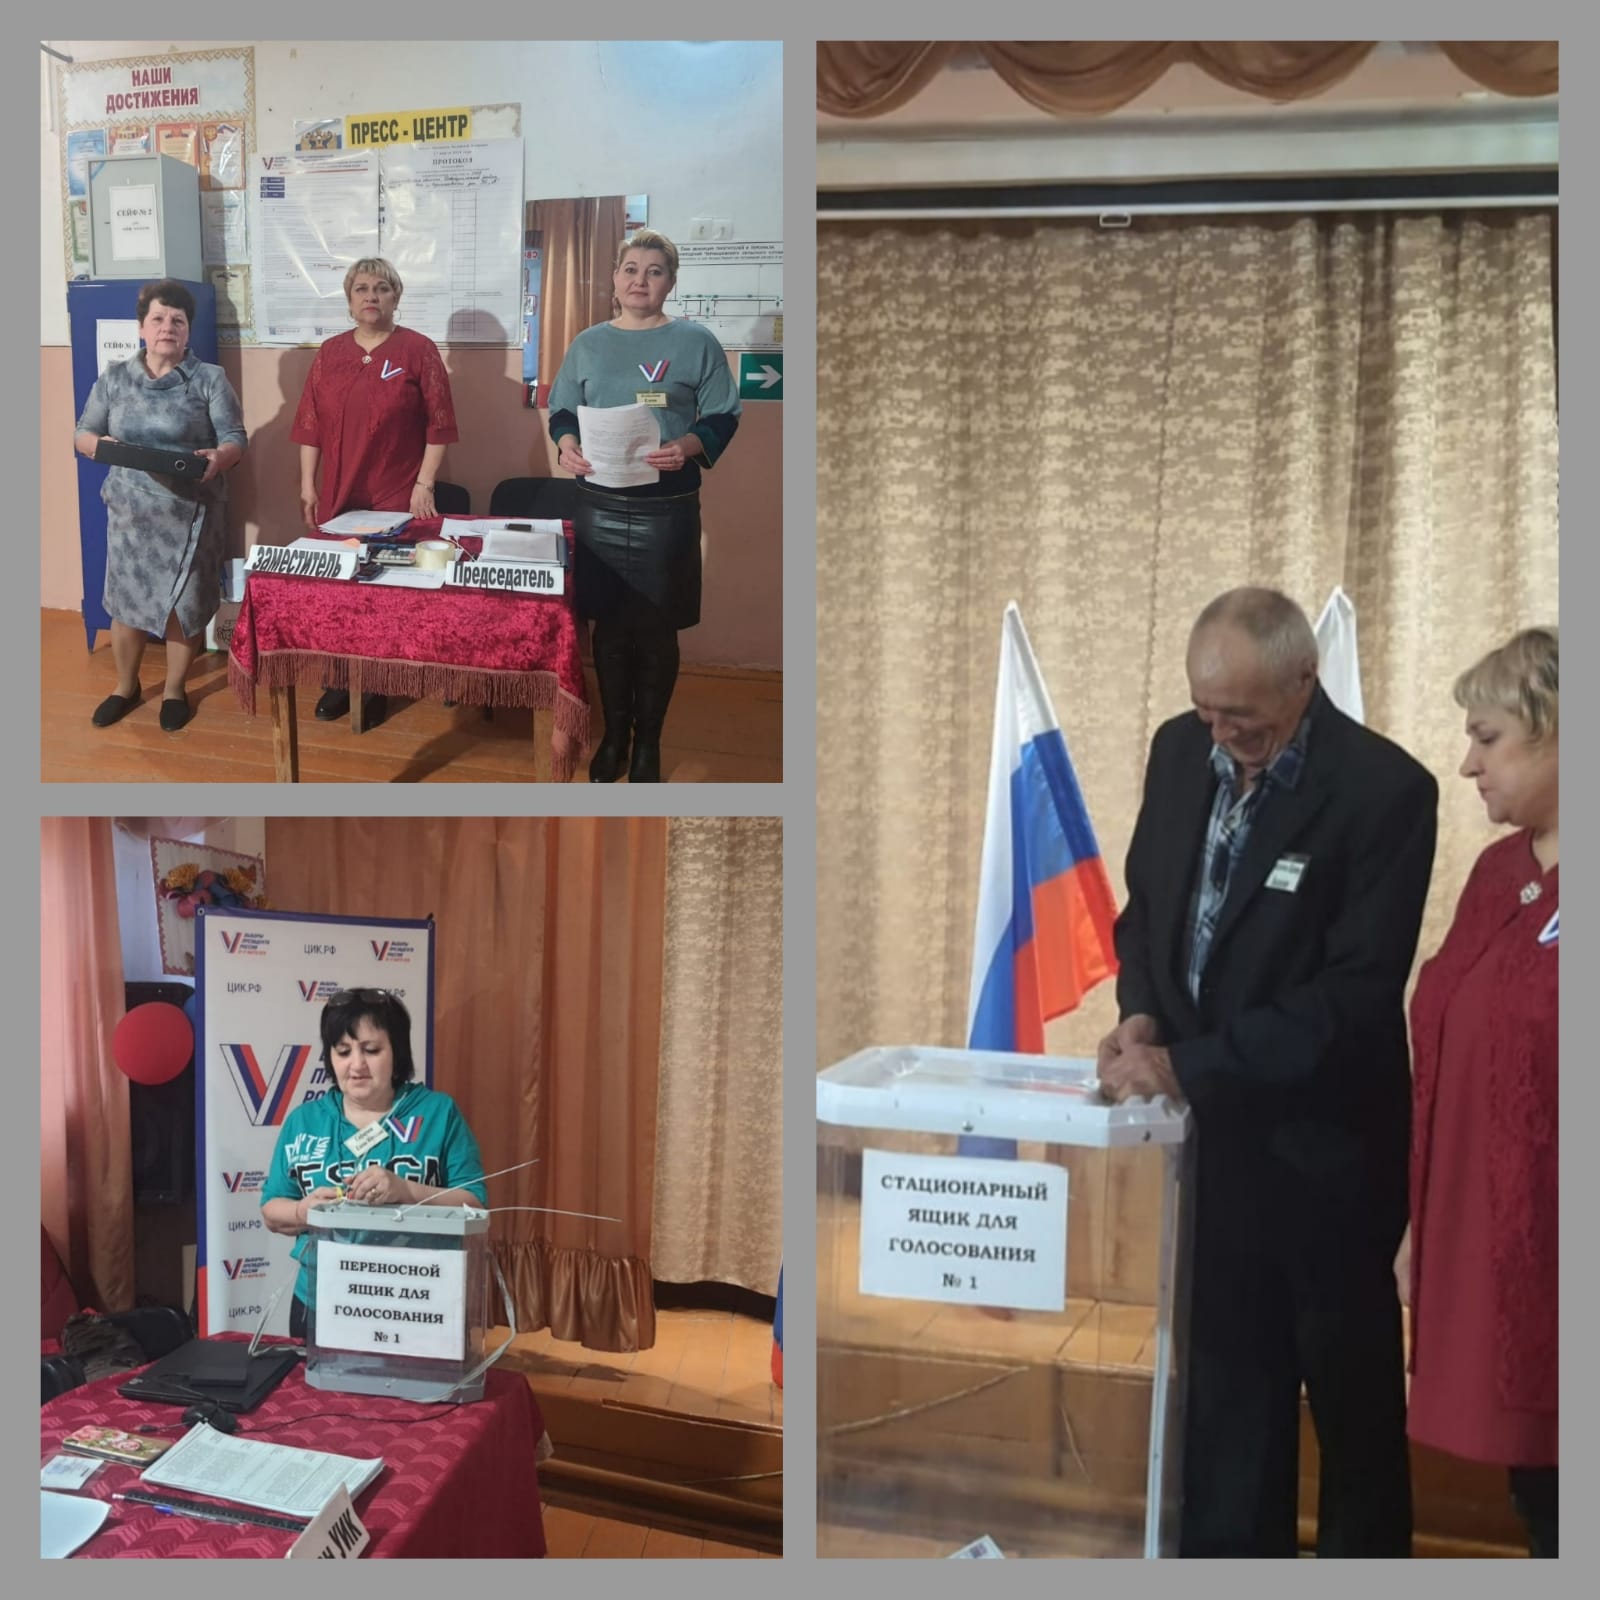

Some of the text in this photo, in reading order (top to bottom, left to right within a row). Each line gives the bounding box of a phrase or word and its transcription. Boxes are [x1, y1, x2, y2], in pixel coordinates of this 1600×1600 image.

[131, 67, 172, 87] НАШИ
[106, 87, 199, 115] ДОСТИЖЕНИЯ
[350, 118, 399, 145] ПРЕСС
[413, 114, 469, 142] ЦЕНТР
[432, 157, 473, 165] ПРОТОКОЛ
[116, 207, 138, 216] СЕЙФ
[104, 341, 124, 349] СЕЙФ
[453, 561, 554, 591] Председатель
[304, 944, 336, 955] ЦИК.РФ
[227, 982, 262, 993] ЦИК.РФ
[880, 1174, 1049, 1201] СТАЦИОНАРНЫЙ
[228, 1219, 262, 1232] ЦИК.РФ
[908, 1208, 1018, 1231] ЯЩИК ДЛЯ
[889, 1238, 1036, 1262] ГОЛОСОВАНИЯ
[339, 1259, 441, 1278] ПЕРЕНОСНОЙ
[942, 1273, 978, 1289] № 1
[347, 1283, 430, 1301] ЯЩИК ДЛЯ
[228, 1305, 262, 1318] ЦИК.РФ
[334, 1305, 444, 1324] ГОЛОСОВАНИЯ
[374, 1331, 400, 1344] № 1
[328, 1507, 363, 1559] УИК
